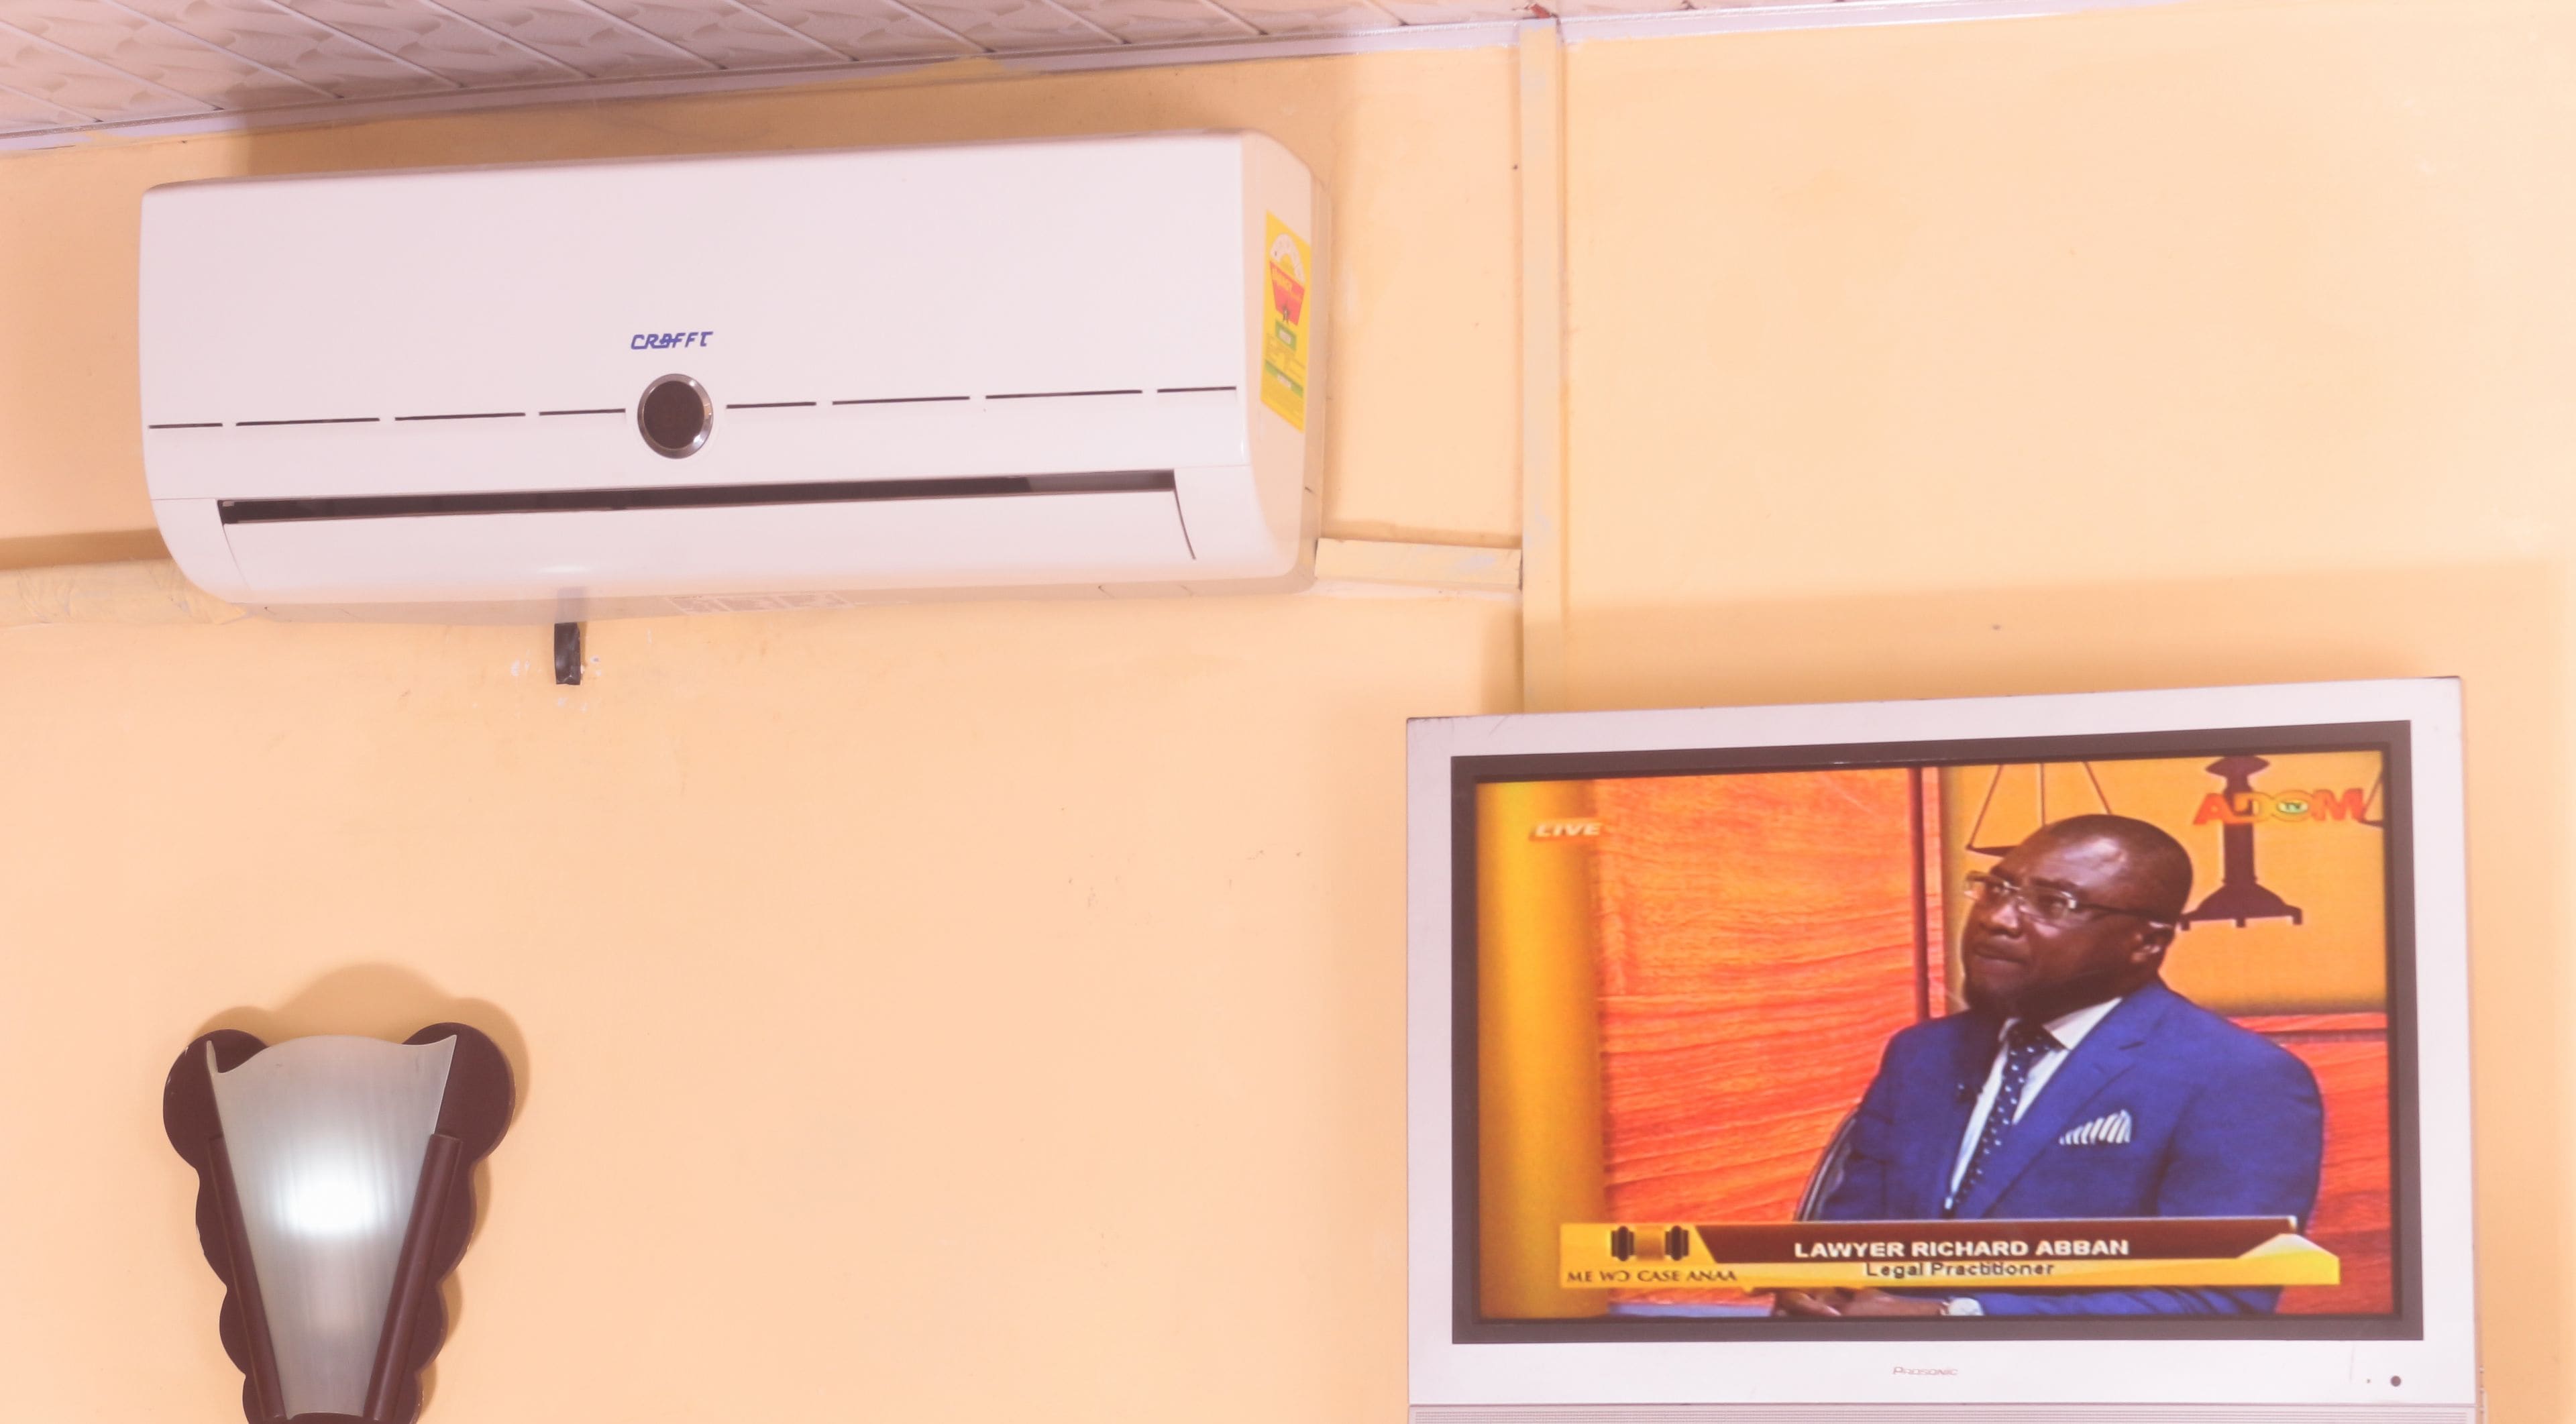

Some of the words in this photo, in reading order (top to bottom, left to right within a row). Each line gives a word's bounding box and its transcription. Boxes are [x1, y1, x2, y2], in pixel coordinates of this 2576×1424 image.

[2193, 788, 2364, 825] ADOM
[1535, 822, 1602, 838] LIVE
[1794, 1242, 1905, 1258] LAWYER
[1912, 1241, 2029, 1257] RICHARD
[2035, 1240, 2129, 1256] ABBAN
[1567, 1270, 1593, 1282] ME
[1637, 1270, 1680, 1282] CASE
[1686, 1270, 1738, 1281] ANAA
[1866, 1262, 1923, 1278] Legal
[1931, 1261, 2054, 1276] Practitioner
